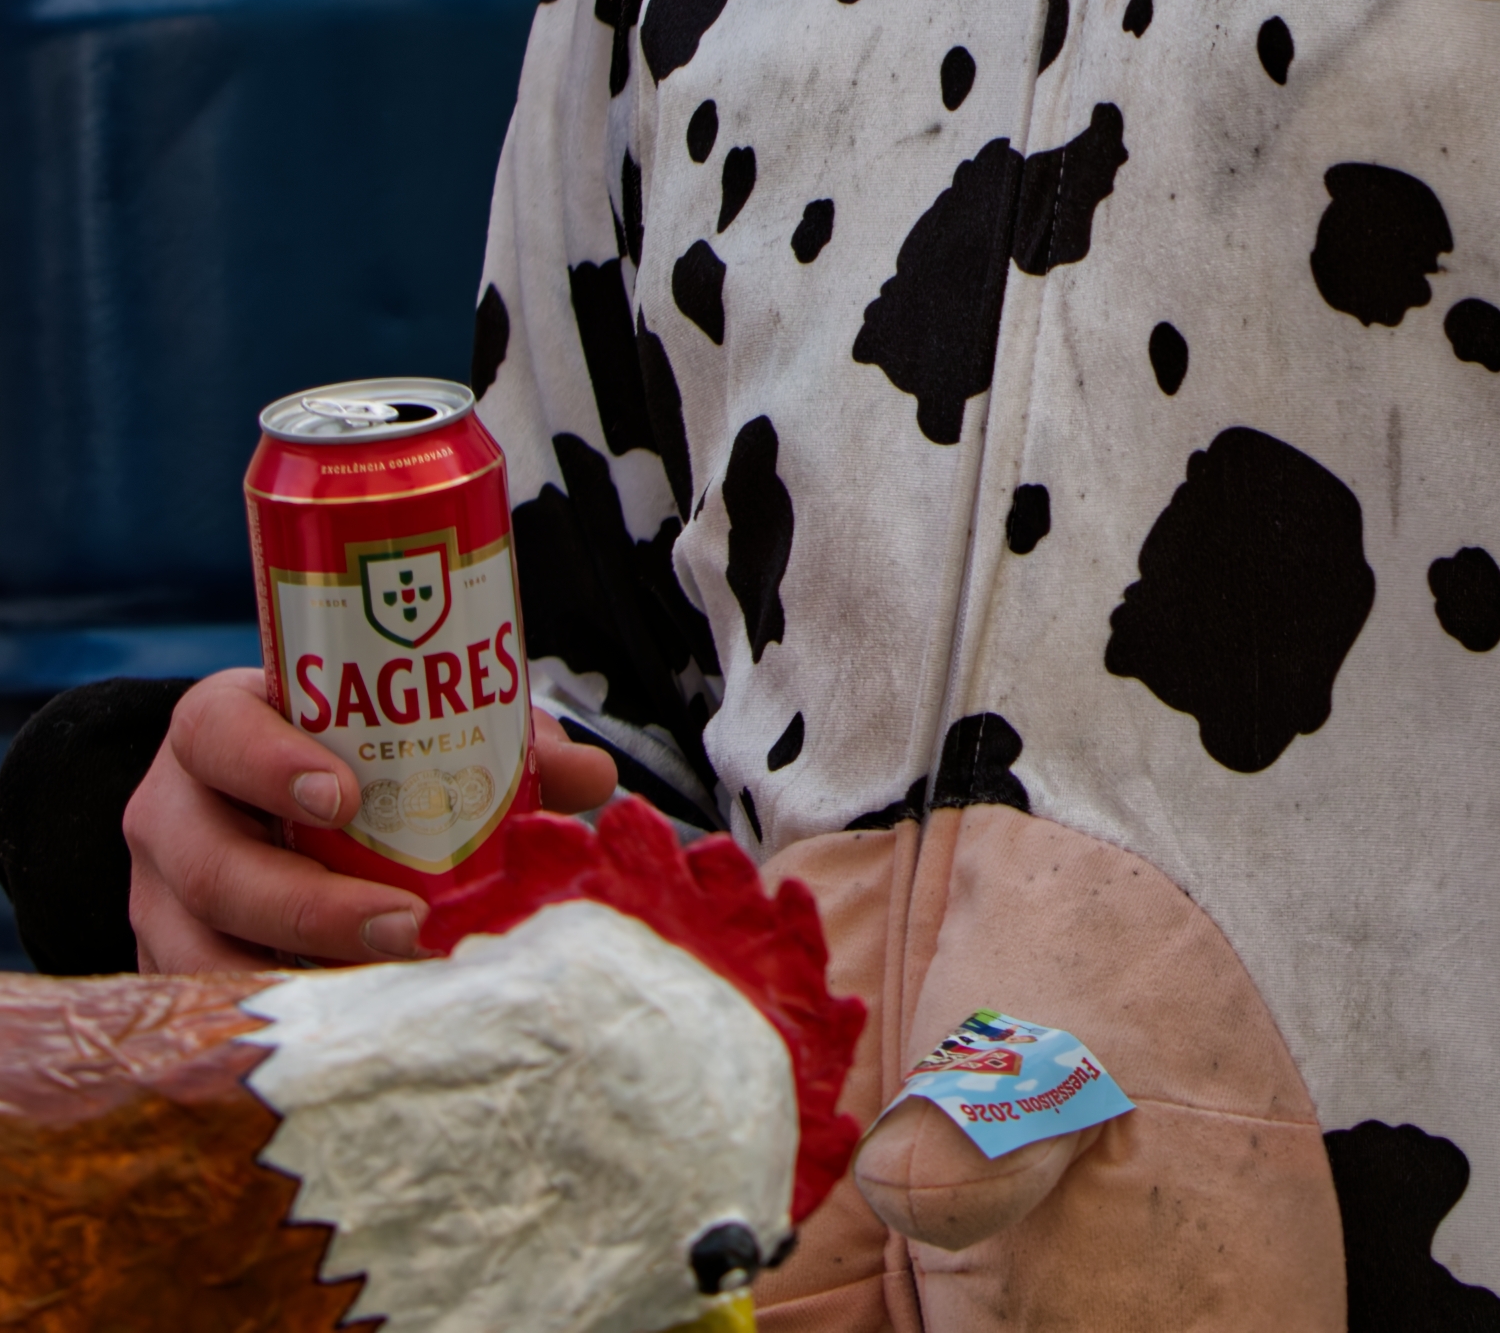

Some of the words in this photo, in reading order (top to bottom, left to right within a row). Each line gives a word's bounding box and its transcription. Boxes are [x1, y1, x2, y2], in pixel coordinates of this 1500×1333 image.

[389, 446, 454, 470] COMPROVADA
[296, 621, 519, 734] SAGRES
[358, 725, 486, 761] CERVEJA
[1014, 1056, 1101, 1114] Fuessaison
[959, 1101, 1021, 1123] 2026
